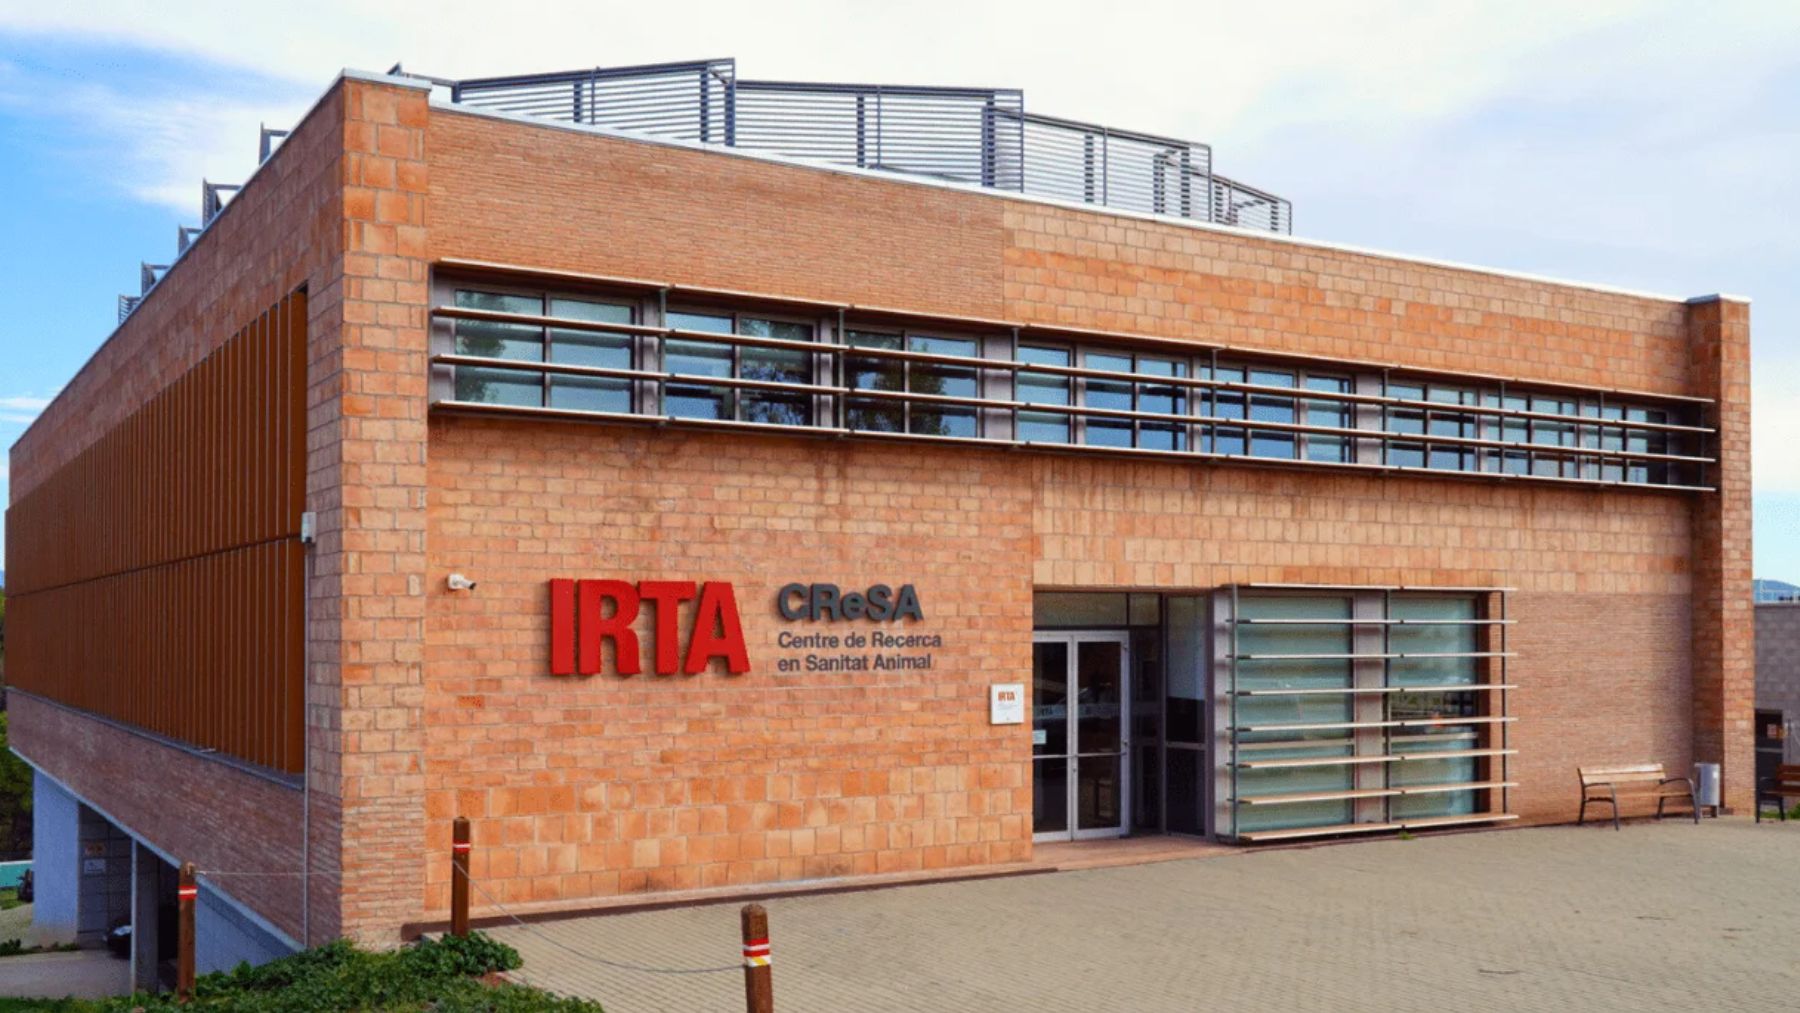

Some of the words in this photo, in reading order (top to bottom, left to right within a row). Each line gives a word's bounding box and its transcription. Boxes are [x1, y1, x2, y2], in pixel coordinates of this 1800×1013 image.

[778, 583, 924, 622] CReSA
[549, 578, 750, 675] IRTA
[778, 631, 839, 648] Centre
[844, 632, 866, 648] de
[871, 631, 942, 648] Recerca
[777, 658, 800, 672] en
[805, 654, 868, 672] Sanitat
[873, 654, 931, 670] Animal
[997, 691, 1015, 701] IRTA
